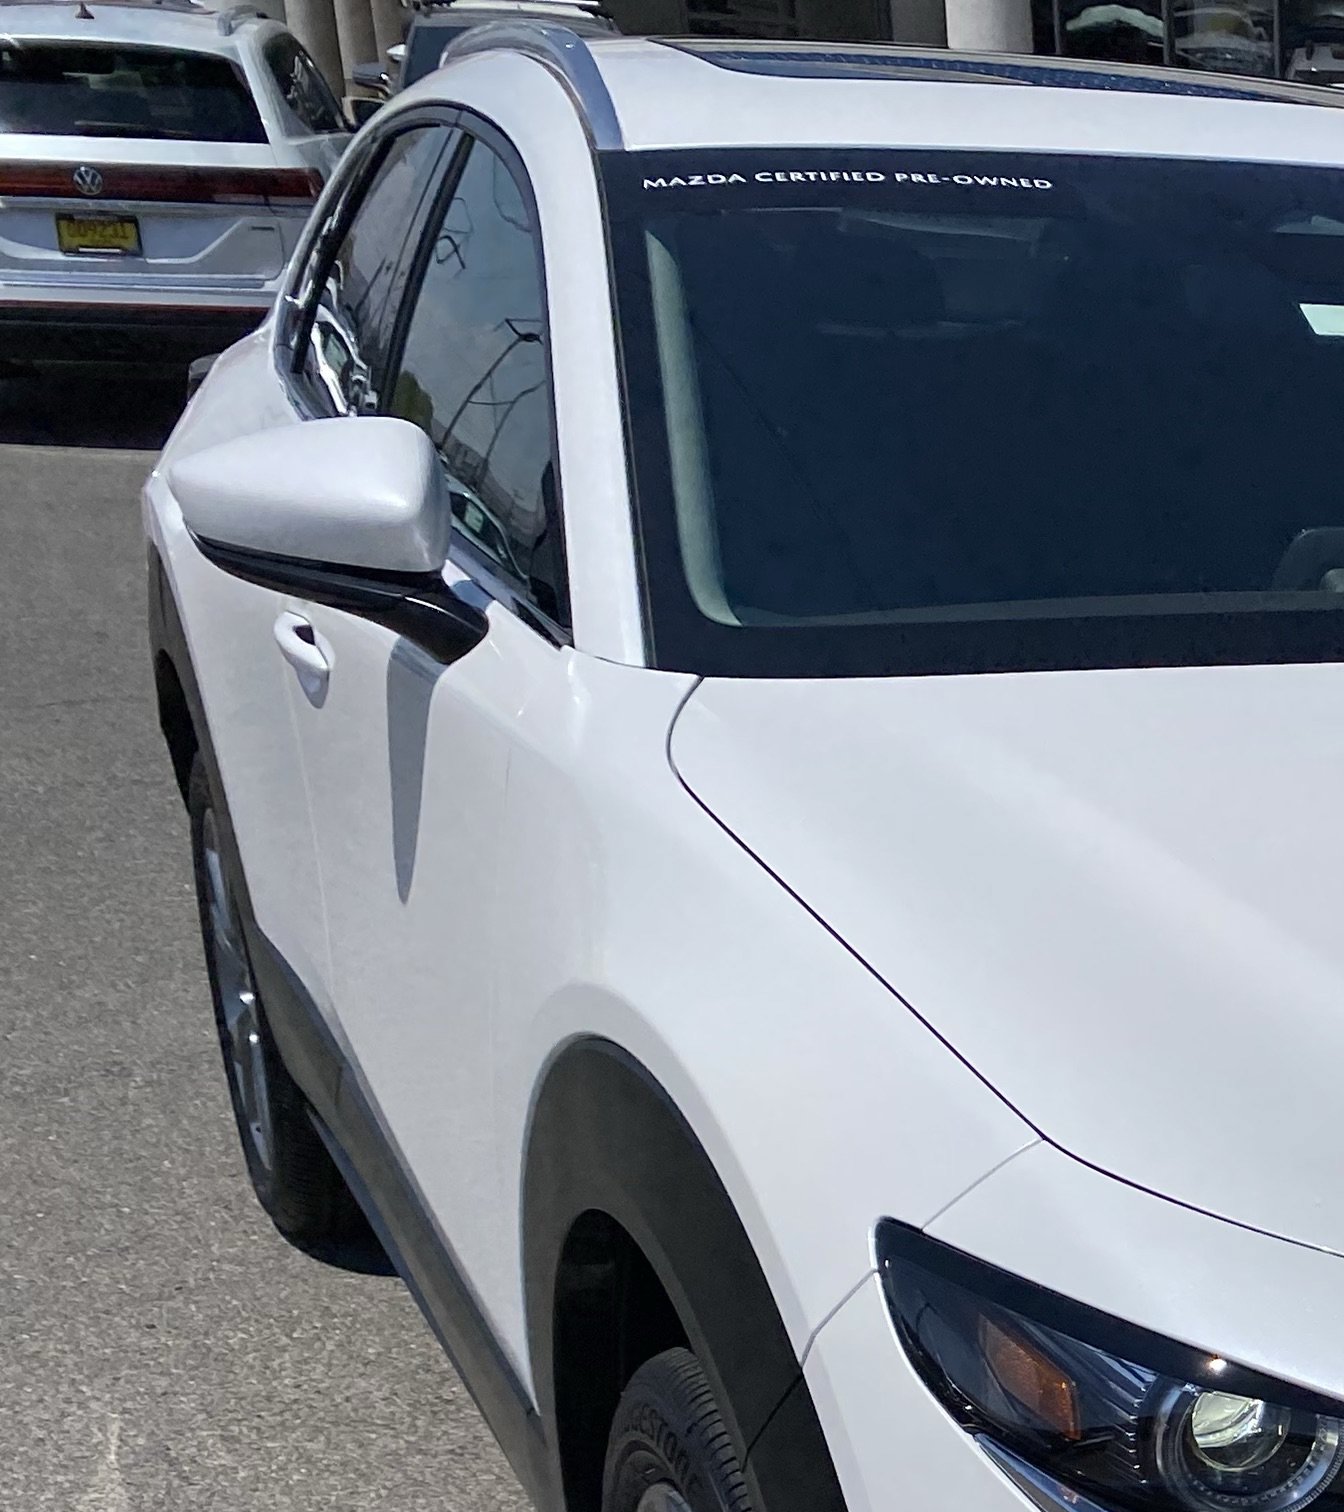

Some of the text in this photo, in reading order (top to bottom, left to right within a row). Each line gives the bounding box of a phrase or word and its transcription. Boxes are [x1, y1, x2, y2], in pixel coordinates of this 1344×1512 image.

[643, 171, 1053, 190] MAZDA CERTIFIED PRE-OWNED
